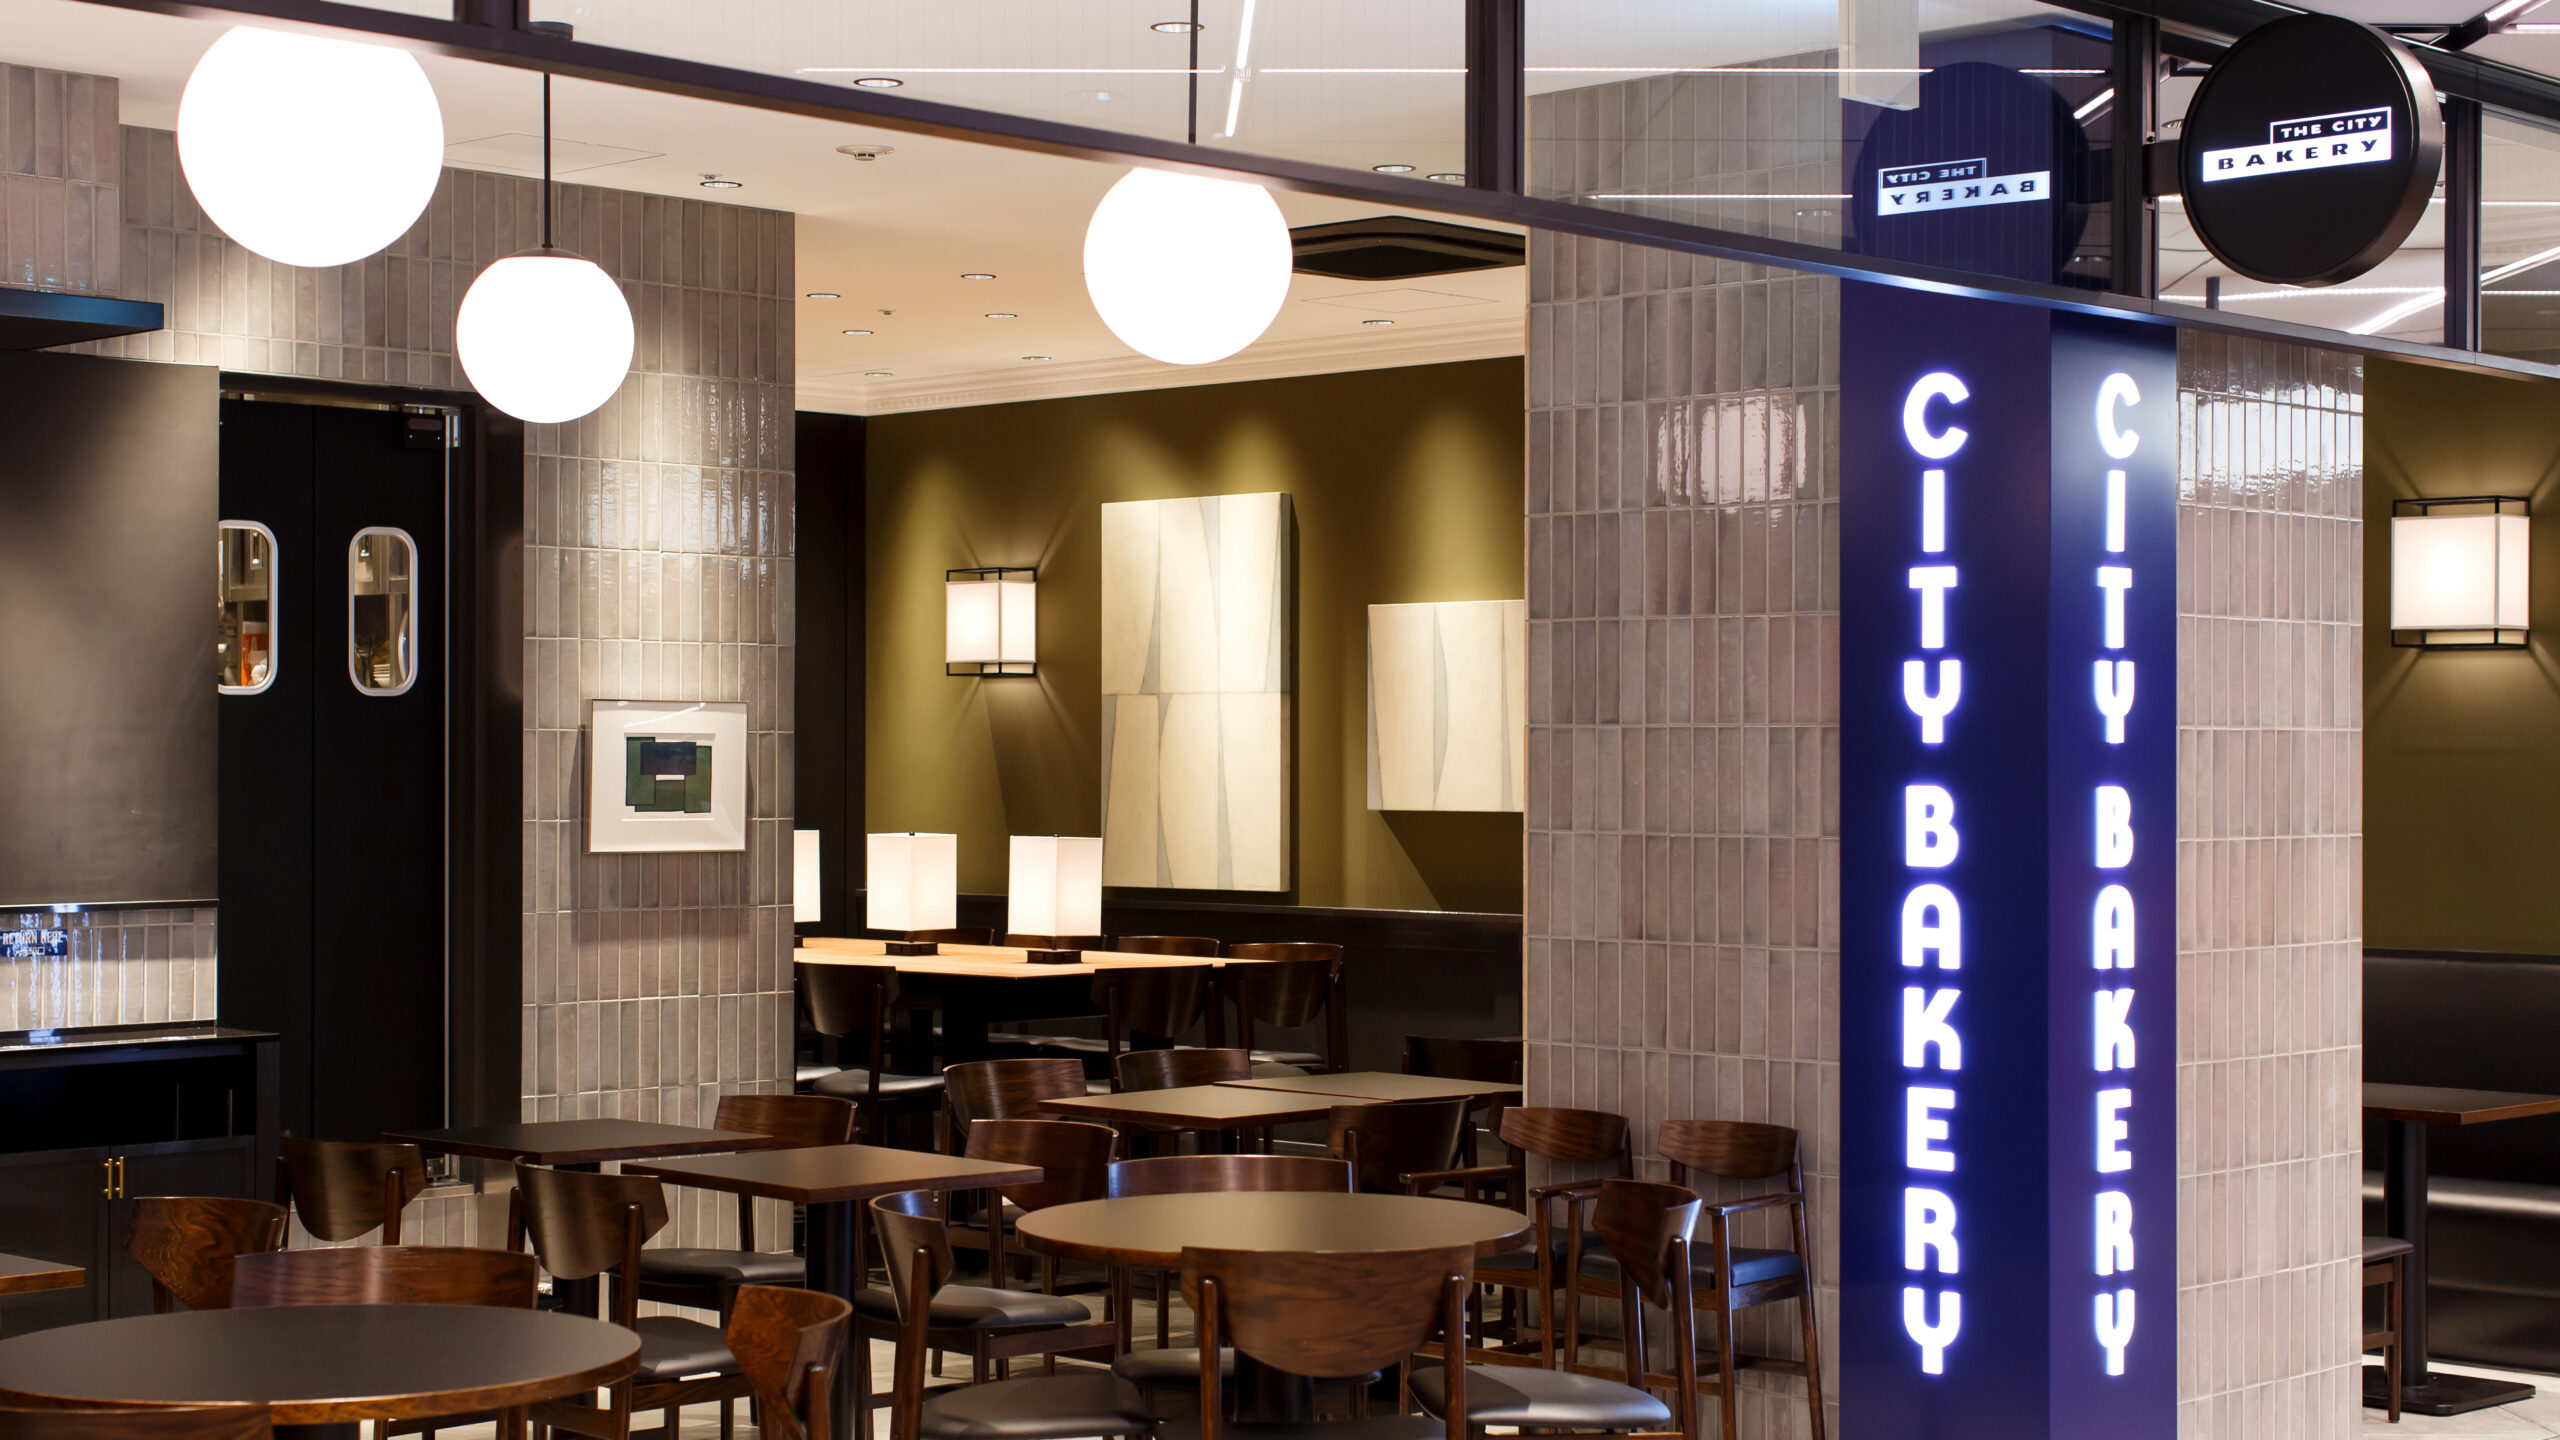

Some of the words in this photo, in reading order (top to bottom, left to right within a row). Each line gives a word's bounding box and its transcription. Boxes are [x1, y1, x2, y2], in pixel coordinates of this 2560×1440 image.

[2218, 139, 2378, 170] BAKERY
[2280, 123, 2322, 138] THE
[2331, 116, 2382, 132] CITY
[1903, 372, 1969, 743] CITY
[2094, 372, 2140, 743] CITY
[2, 931, 37, 945] RETURN
[41, 930, 64, 944] HERE
[1901, 785, 1962, 1375] BAKERY
[2093, 785, 2137, 1377] BAKERY
